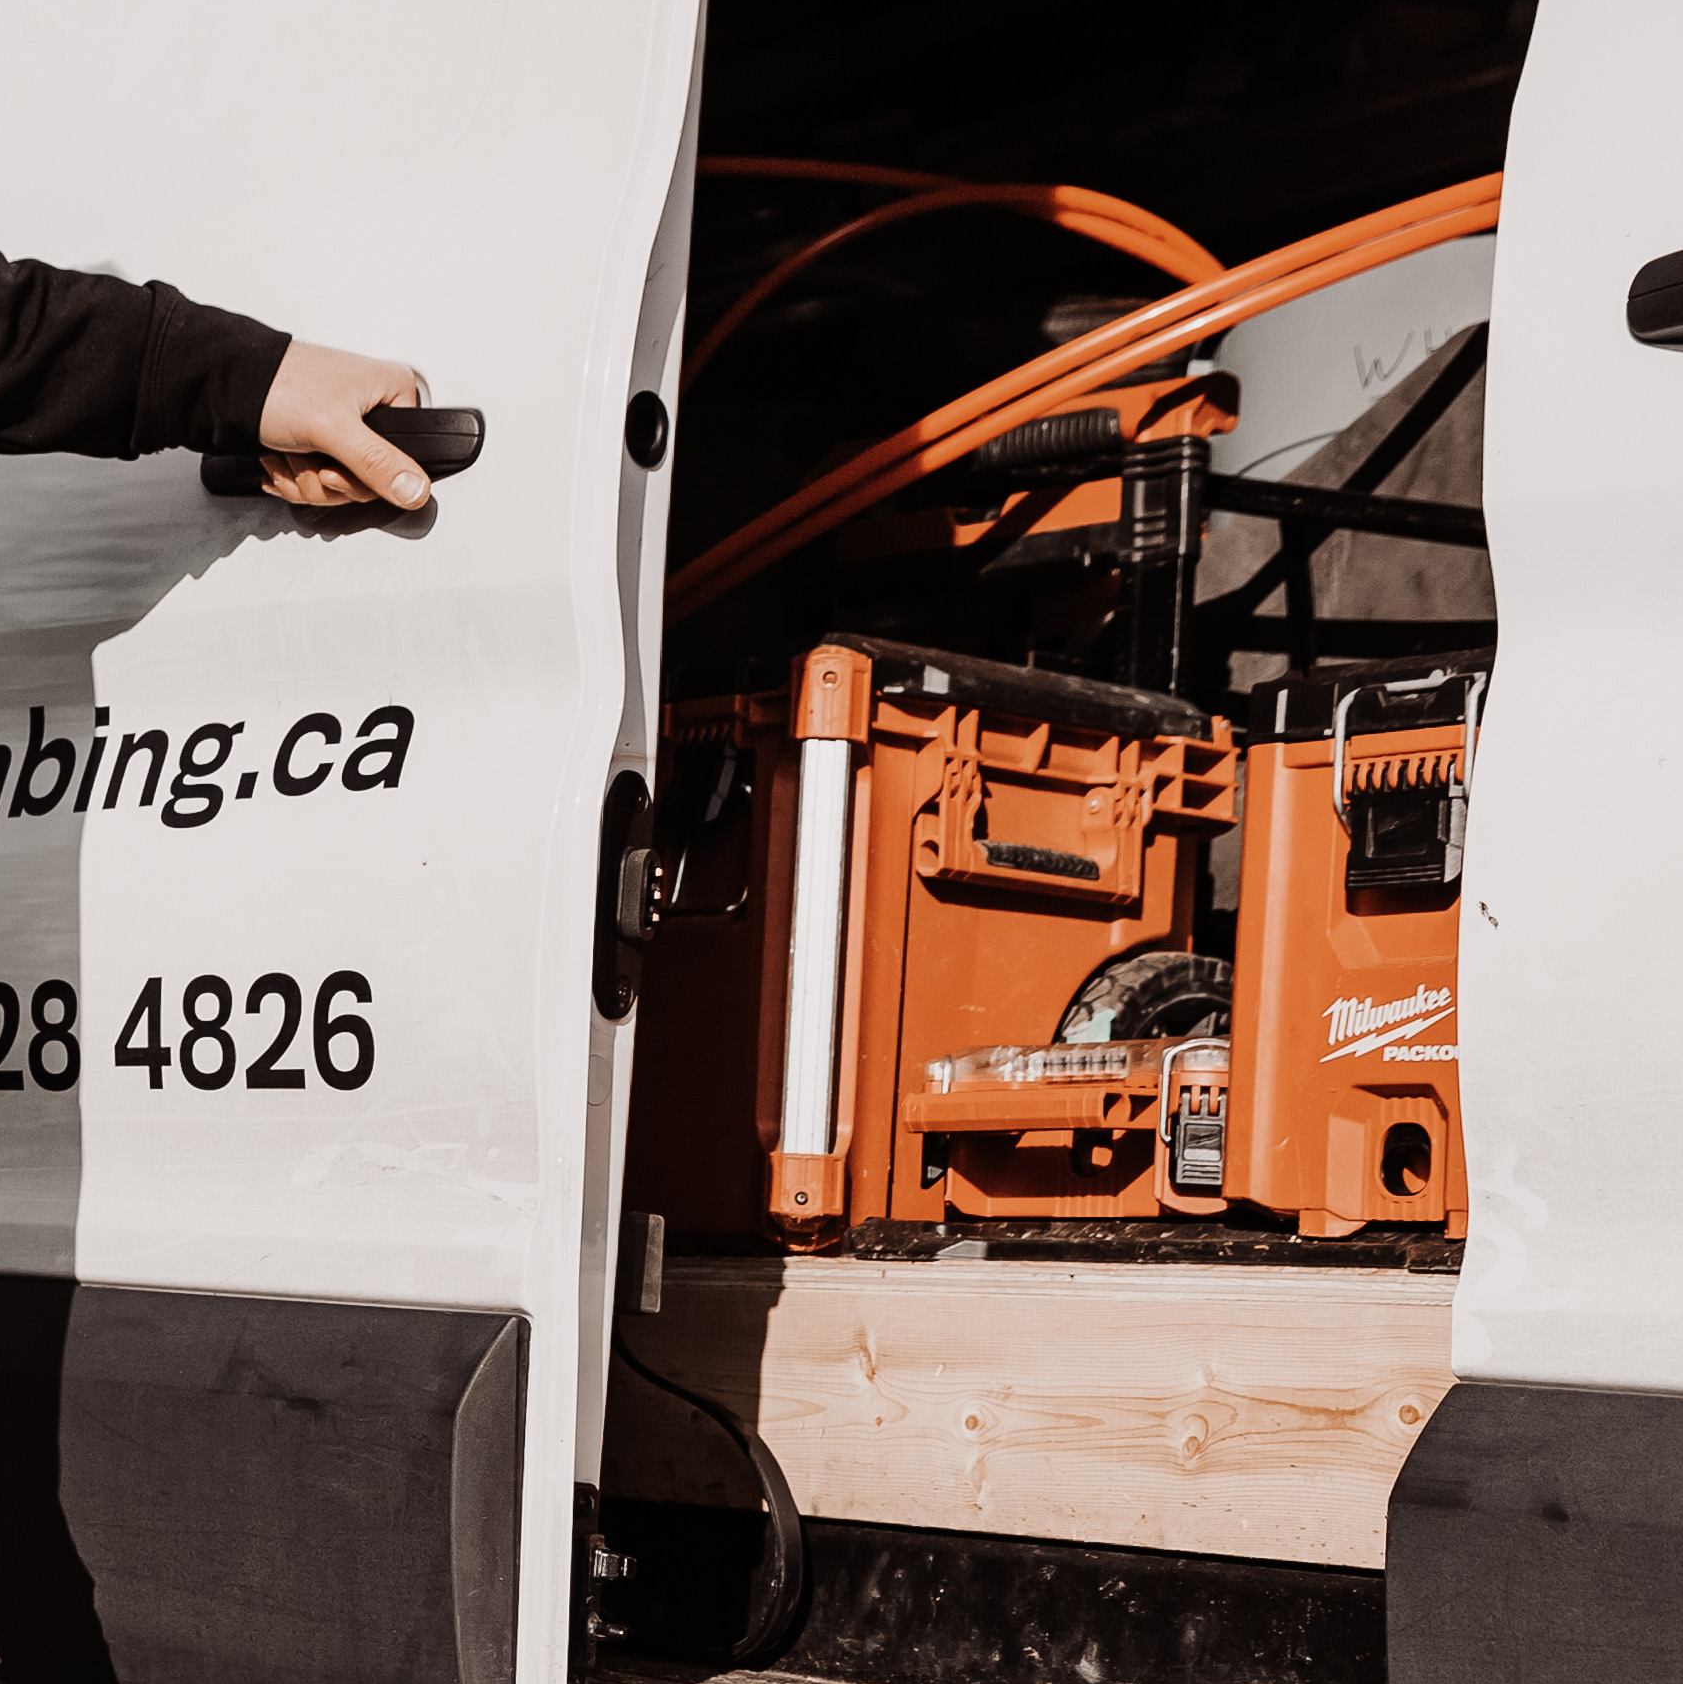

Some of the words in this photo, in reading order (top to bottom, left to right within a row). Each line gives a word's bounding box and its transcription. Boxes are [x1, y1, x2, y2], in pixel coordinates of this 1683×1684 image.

[114, 969, 375, 1091] 4826
[1321, 983, 1453, 1046] Milwaukee
[1382, 1044, 1459, 1062] PACKO
